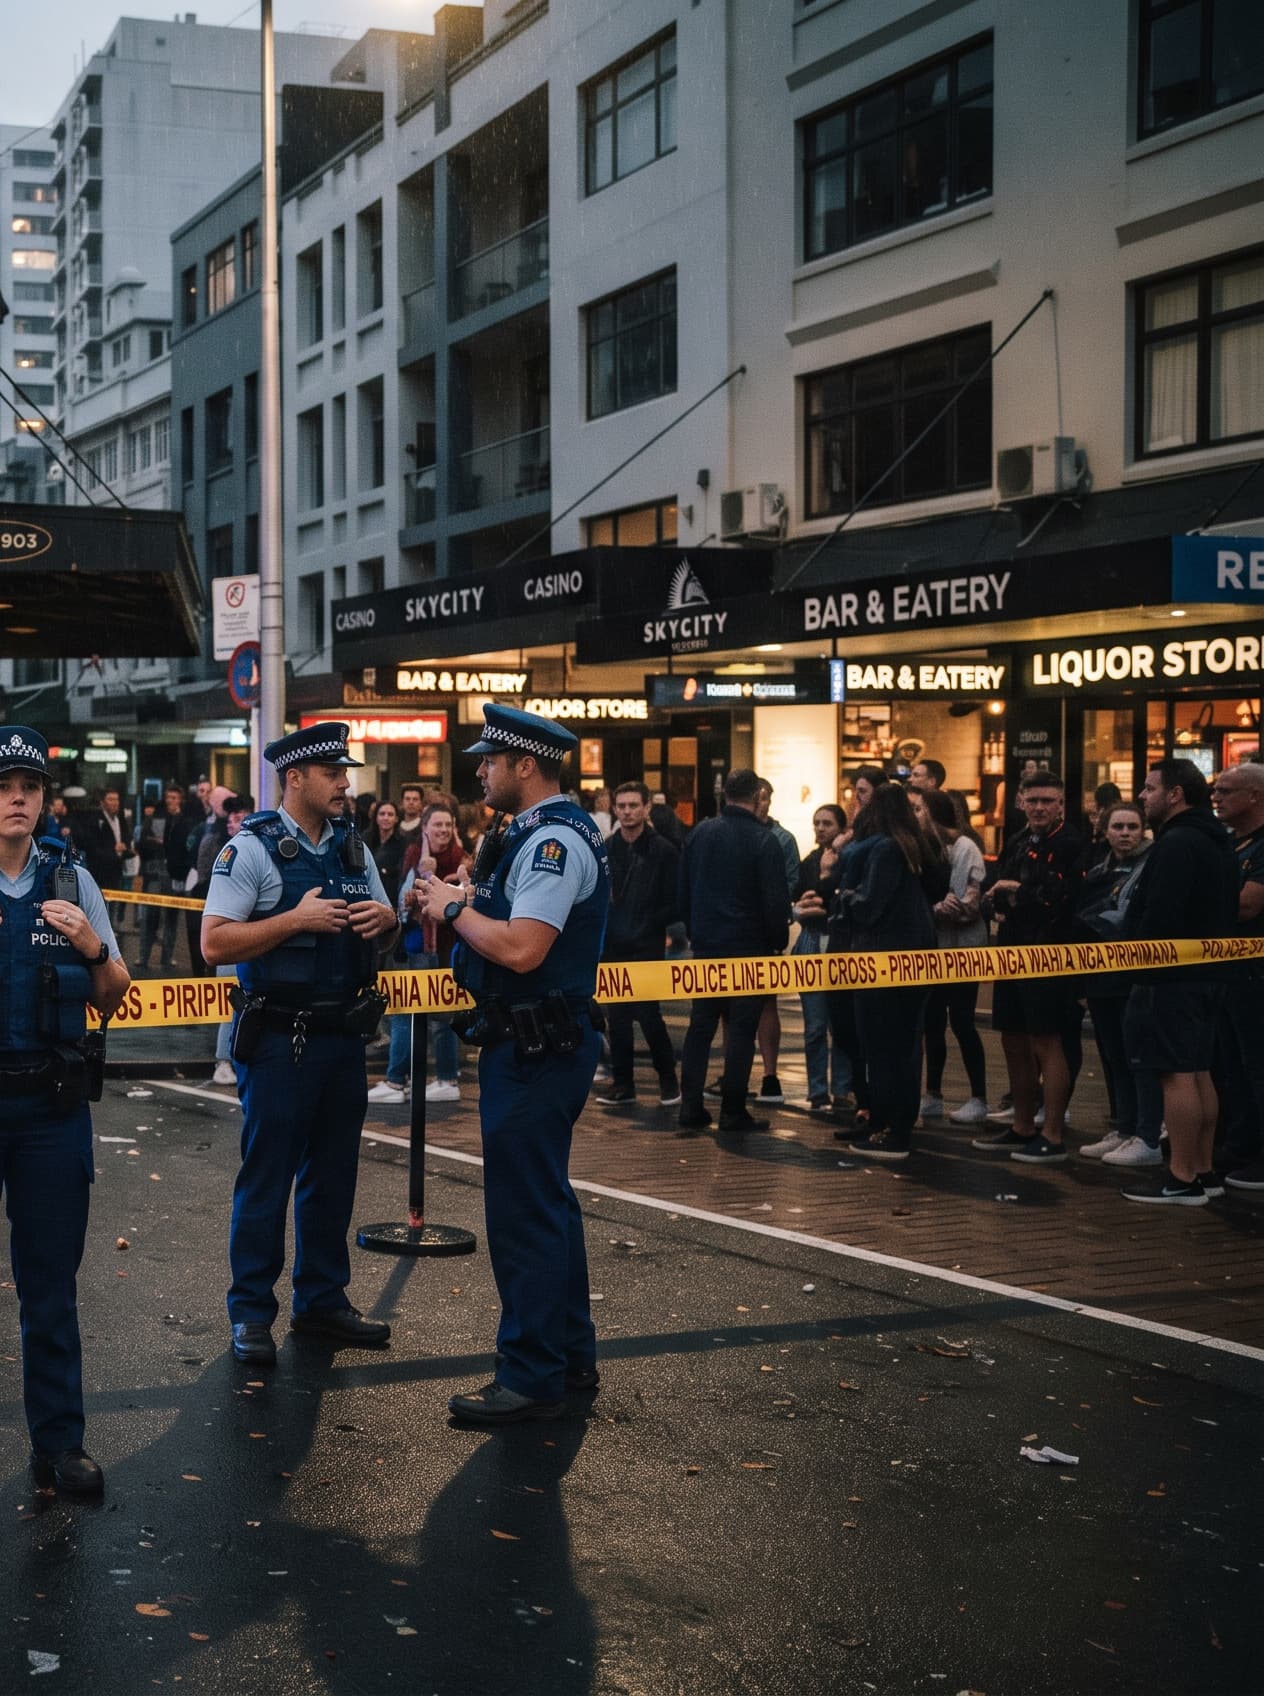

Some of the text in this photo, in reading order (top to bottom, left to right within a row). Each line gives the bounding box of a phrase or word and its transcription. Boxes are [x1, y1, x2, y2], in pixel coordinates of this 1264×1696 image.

[336, 570, 583, 631] CASINO SKYCITY CASINO
[804, 572, 1011, 631] BAR & EATERY
[644, 612, 728, 643] SKYCITY
[1033, 635, 1264, 687] LIQUOR STOR
[397, 671, 527, 692] BAR & EATERY
[846, 665, 894, 690] BAR
[897, 665, 915, 690] &
[919, 665, 1005, 690] EATERY
[587, 699, 648, 718] STORE
[671, 964, 728, 994] POLICE
[732, 962, 765, 991] LINE
[769, 960, 790, 988] DO
[794, 959, 823, 987] NOT
[828, 956, 877, 985] CROSS
[888, 951, 943, 982] PIRIPIRI
[945, 949, 995, 979] PIRIHIA
[998, 948, 1027, 975] NGA
[1079, 944, 1107, 970] NGA
[427, 974, 469, 1006] NGA
